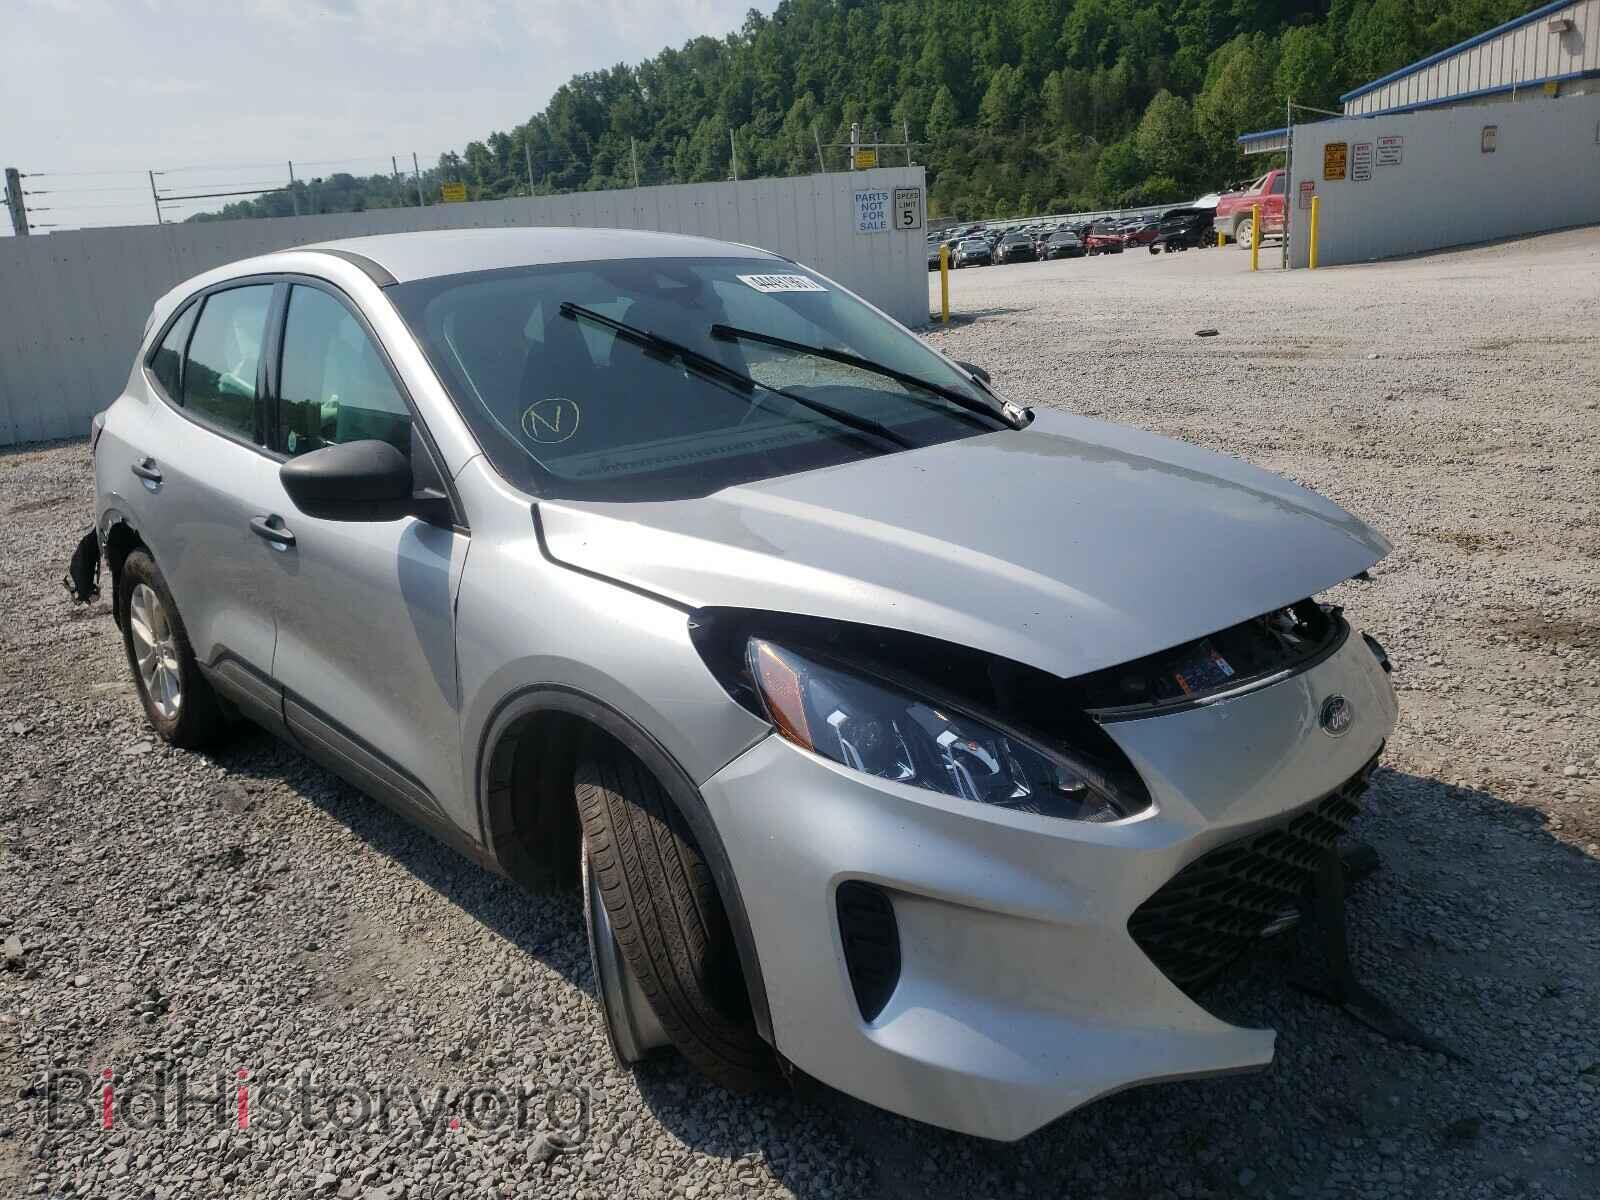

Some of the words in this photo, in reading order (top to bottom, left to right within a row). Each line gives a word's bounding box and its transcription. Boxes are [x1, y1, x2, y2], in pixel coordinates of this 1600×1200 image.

[856, 192, 888, 202] PARTS
[896, 192, 919, 200] SPEED
[861, 202, 882, 211] NOT
[862, 211, 884, 220] FOR
[904, 210, 914, 225] 5
[860, 221, 886, 230] SALE
[530, 406, 561, 437] N
